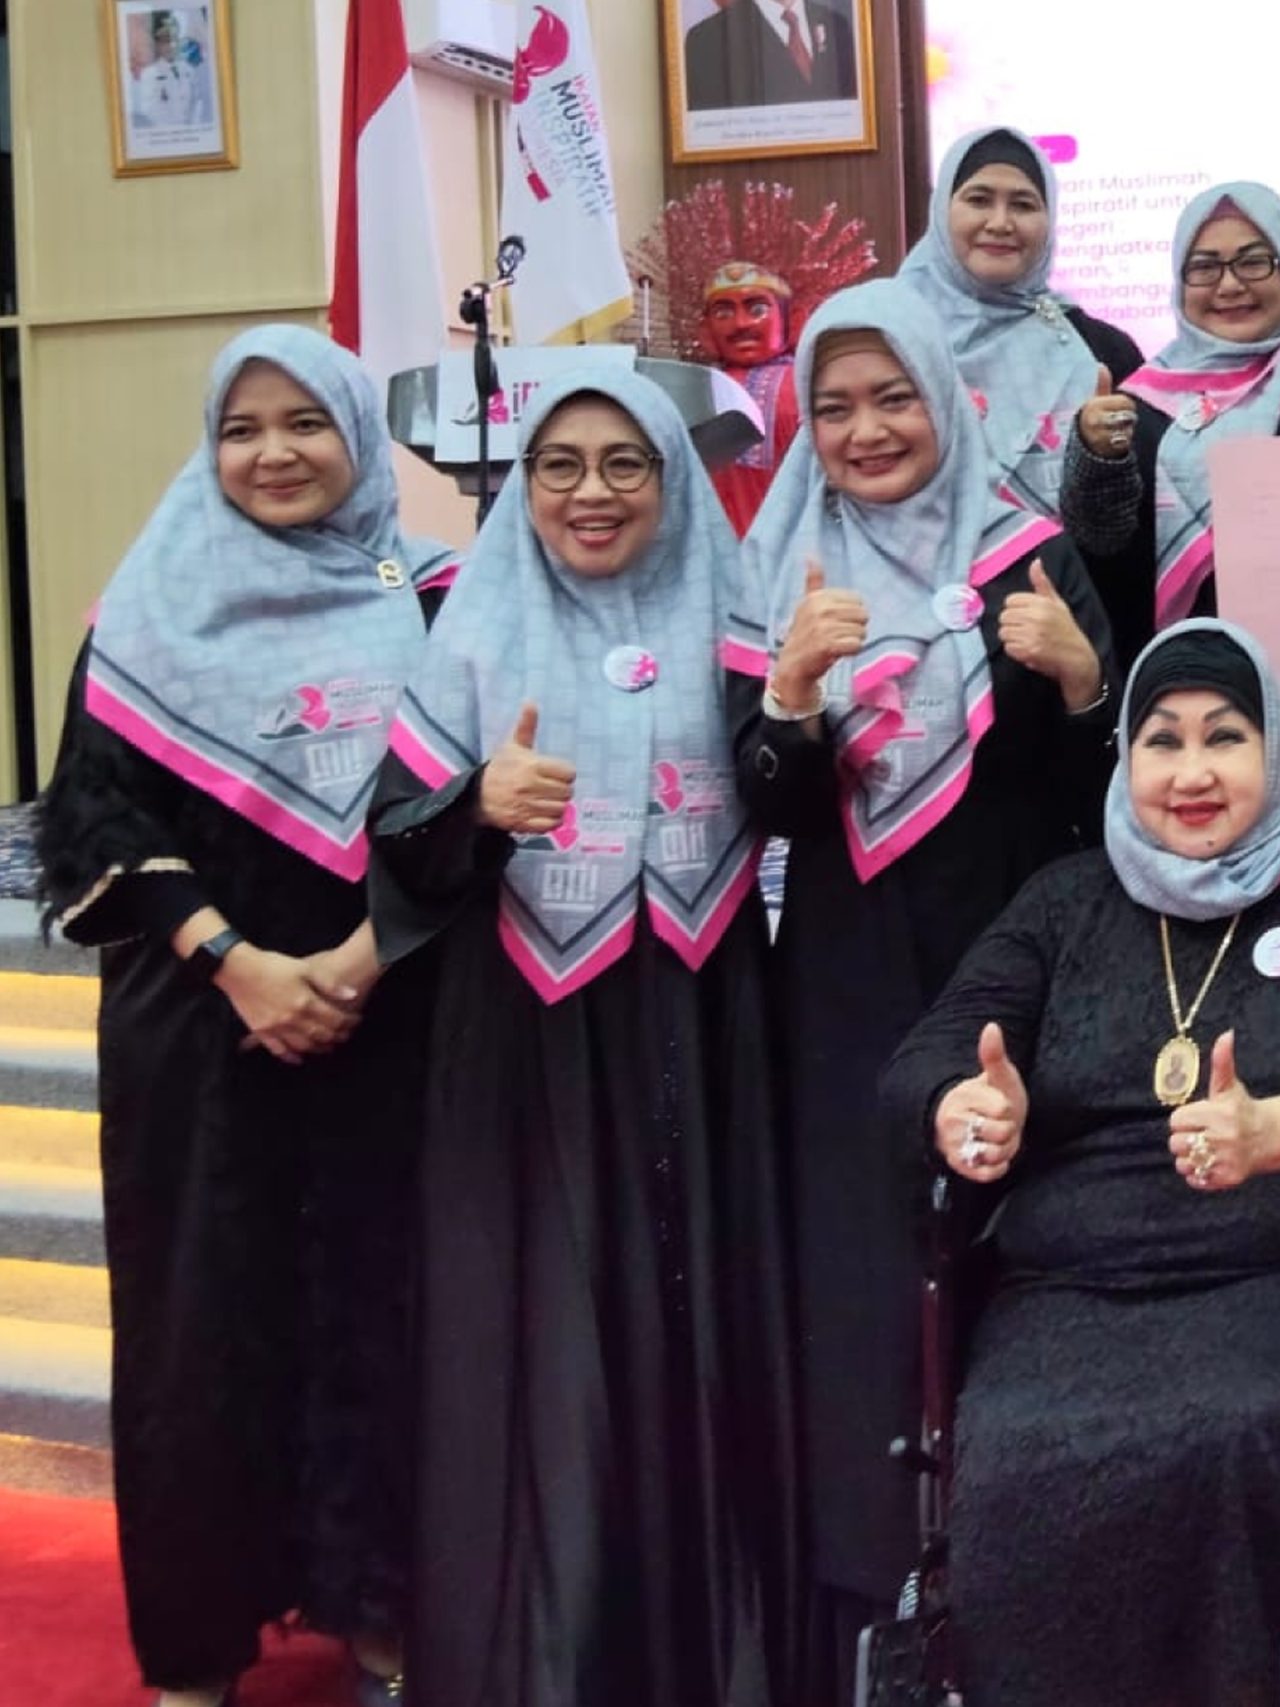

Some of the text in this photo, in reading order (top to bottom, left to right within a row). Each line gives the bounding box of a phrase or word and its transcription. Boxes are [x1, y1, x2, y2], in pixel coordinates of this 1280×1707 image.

[1058, 170, 1212, 193] ari Muslimah
[1059, 195, 1138, 219] spiratif
[1056, 220, 1116, 241] egeri
[1055, 238, 1172, 262] enguatka
